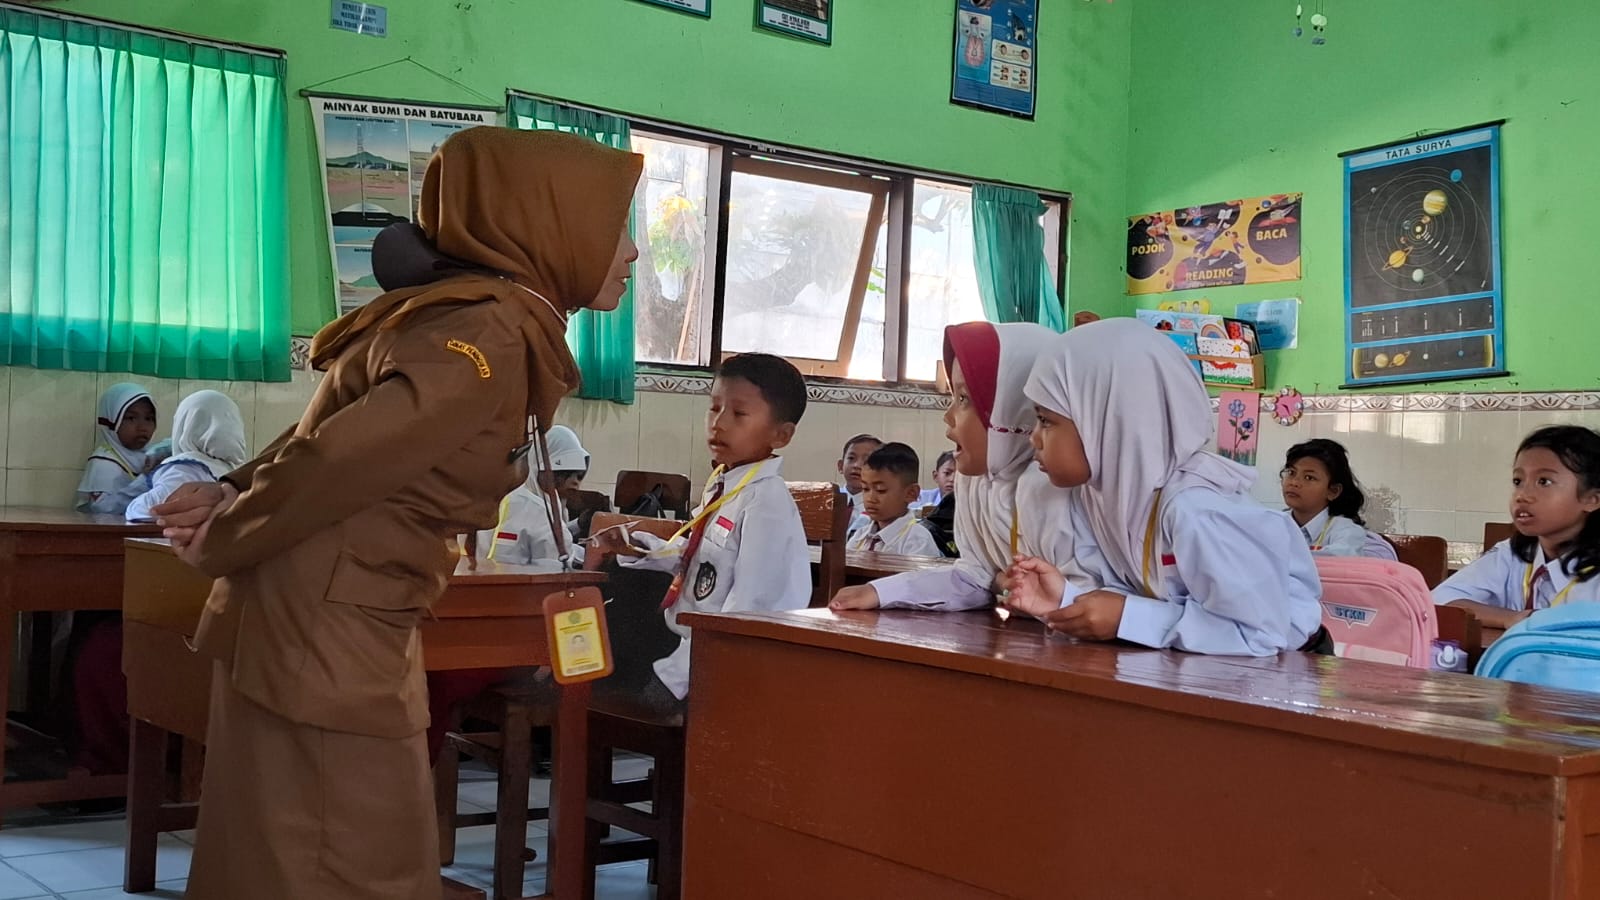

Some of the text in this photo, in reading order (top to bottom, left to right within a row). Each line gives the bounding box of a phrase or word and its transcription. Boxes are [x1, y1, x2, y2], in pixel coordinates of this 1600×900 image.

[323, 101, 484, 122] MINYAK BUMI DAN BATUBARA
[1385, 139, 1452, 160] TATA SURYA
[1131, 227, 1288, 256] POJOK BACA
[1185, 267, 1234, 281] READING
